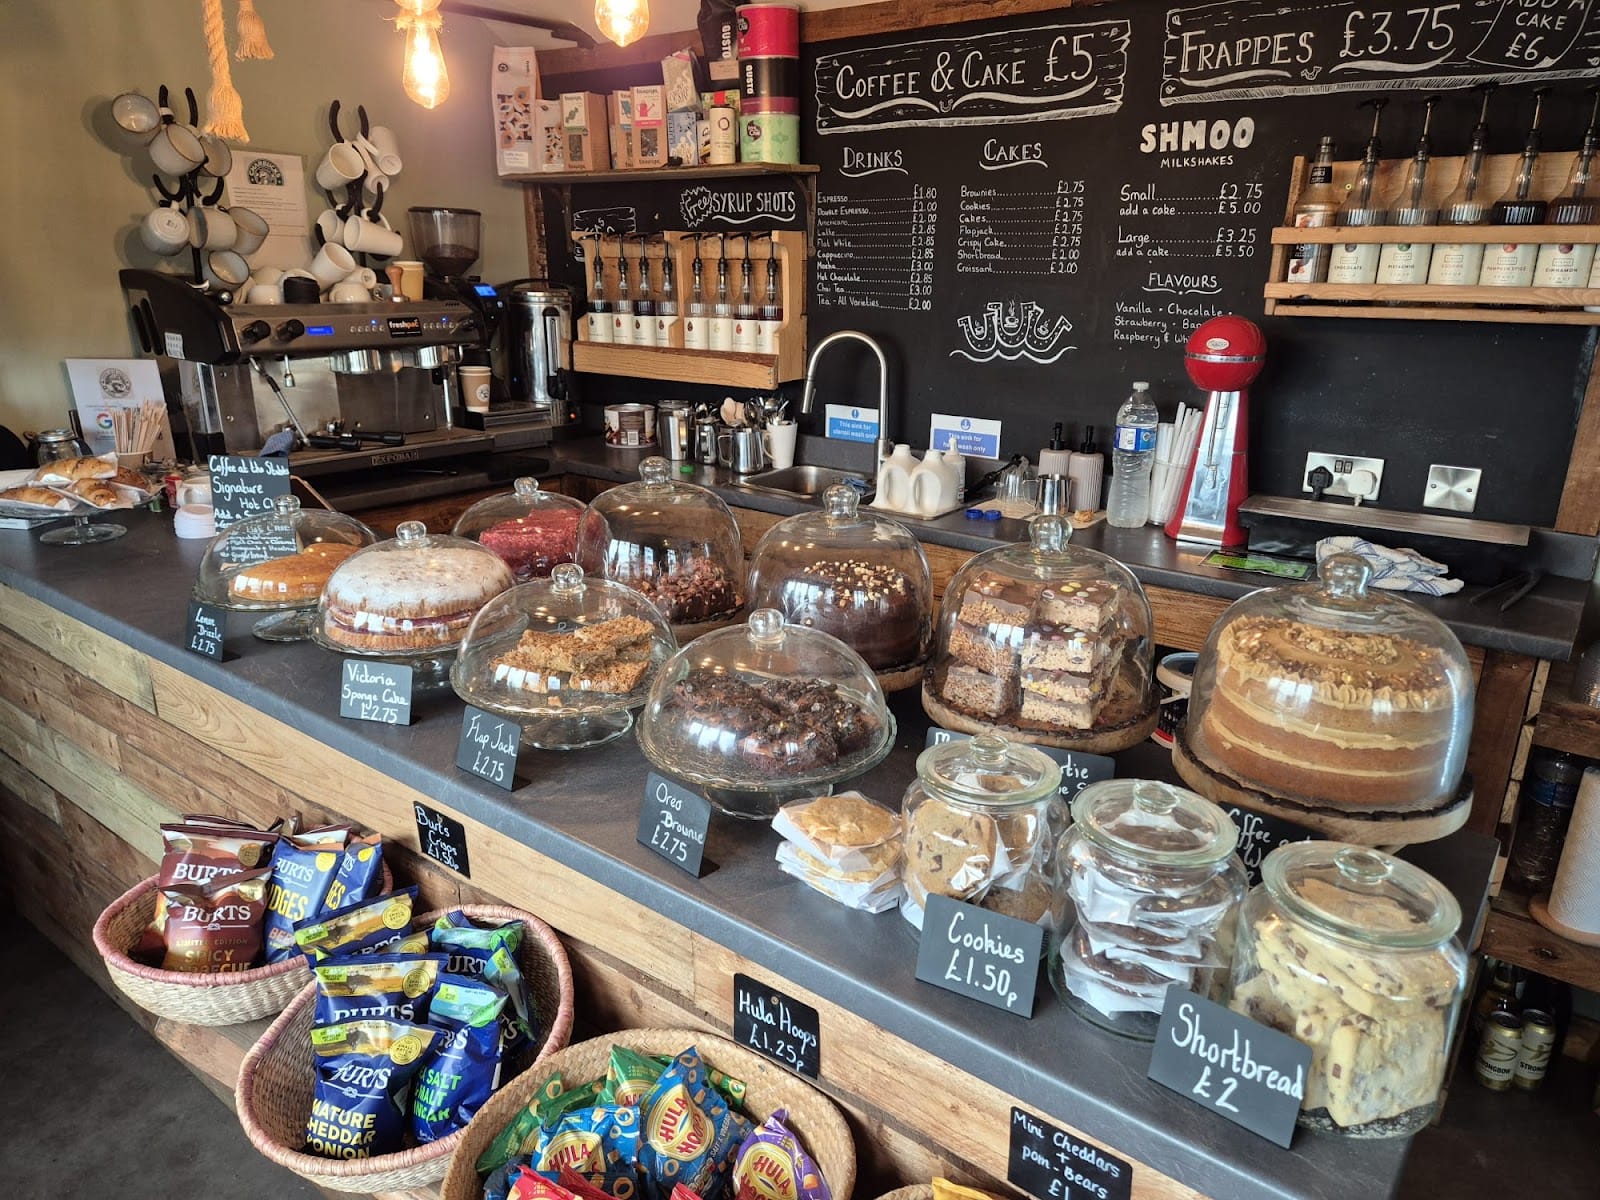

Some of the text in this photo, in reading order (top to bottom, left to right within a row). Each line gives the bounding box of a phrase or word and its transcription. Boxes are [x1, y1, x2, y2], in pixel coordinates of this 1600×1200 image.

[1515, 11, 1568, 31] CAKE
[721, 24, 732, 59] GUSTO
[1180, 4, 1460, 73] FRAPPES £3.75
[1504, 31, 1545, 61] £6
[836, 33, 1095, 100] COFFEE & CAKE £5
[745, 64, 754, 95] GUSTO
[1140, 116, 1255, 153] SHMOO
[842, 146, 903, 169] DRINKS
[983, 138, 1042, 161] CAKES
[1160, 155, 1234, 169] MILKSHAKES
[711, 191, 752, 213] SYRUP
[756, 190, 796, 213] SHOTS
[960, 185, 998, 198] Brownies
[1120, 182, 1264, 201] Small £2.75
[960, 200, 991, 211] Cookies
[1119, 203, 1139, 216] add
[1152, 204, 1176, 216] cake
[1218, 201, 1262, 214] £5.00
[959, 213, 987, 223] Cakes
[960, 225, 993, 238] Flapjack
[1118, 225, 1257, 248] Large £3.25
[957, 237, 982, 251] Crispy
[984, 237, 1006, 248] Cake
[957, 249, 1001, 260] Shortbread
[1116, 246, 1133, 257] add
[1147, 245, 1169, 258] cake
[1215, 245, 1255, 258] £5.50
[956, 262, 993, 273] Croissant
[1148, 272, 1218, 288] FLAVOURS
[1115, 301, 1223, 317] Vanilla Chocolate
[1114, 315, 1203, 333] Strawberry Ban
[1113, 329, 1161, 349] Raspberry
[973, 445, 986, 453] only
[209, 455, 237, 477] Coffee
[238, 459, 249, 474] at
[250, 459, 265, 474] the
[213, 475, 264, 501] Signature
[214, 508, 233, 520] Add
[240, 497, 261, 510] Hot
[347, 663, 397, 686] Victoria
[341, 683, 409, 710] Sponge Cake
[360, 702, 399, 724] £2.75
[466, 713, 517, 757] Flap Jack
[472, 751, 505, 781] £2.75
[656, 782, 683, 811] Oreo
[415, 805, 451, 838] Burts
[650, 823, 688, 862] £2.75
[182, 904, 252, 923] BURTS
[948, 911, 1025, 964] Cookies
[184, 949, 234, 963] SPICY
[446, 955, 488, 975] URT
[944, 948, 1018, 1008] £1.50p
[739, 988, 817, 1056] Hula Hoops
[749, 1023, 805, 1073] £1.25p
[1171, 1003, 1304, 1100] Shortbread
[426, 1068, 462, 1091] SALT
[1191, 1064, 1240, 1113] £2
[306, 1116, 377, 1145] HEDDAR
[659, 1097, 690, 1143] HULA
[1013, 1110, 1121, 1178] Mini Cheddars
[548, 1143, 594, 1172] HULA
[752, 1155, 791, 1196] HULA
[1063, 1165, 1109, 1200] Bears
